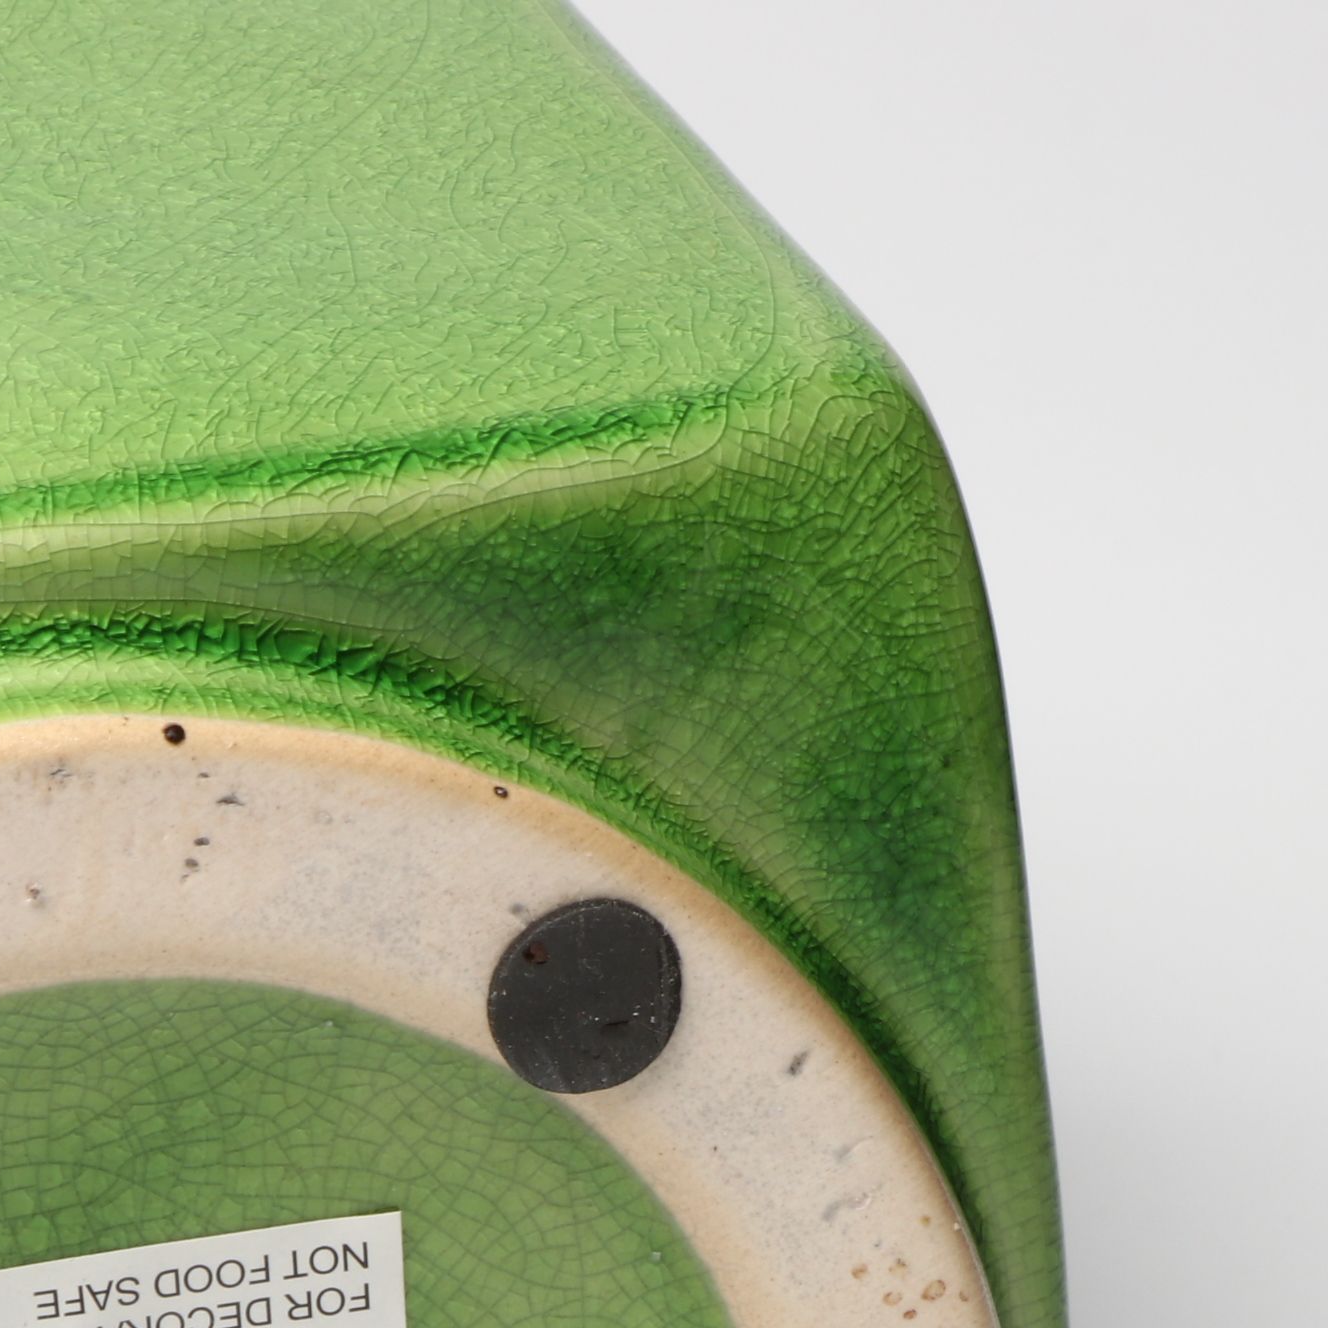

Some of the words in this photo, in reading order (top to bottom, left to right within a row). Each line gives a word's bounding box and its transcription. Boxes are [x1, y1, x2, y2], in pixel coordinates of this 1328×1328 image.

[154, 1254, 271, 1299] FOOD
[283, 1241, 370, 1281] NOT
[33, 1276, 140, 1320] SAFE
[286, 1283, 372, 1322] FOR
